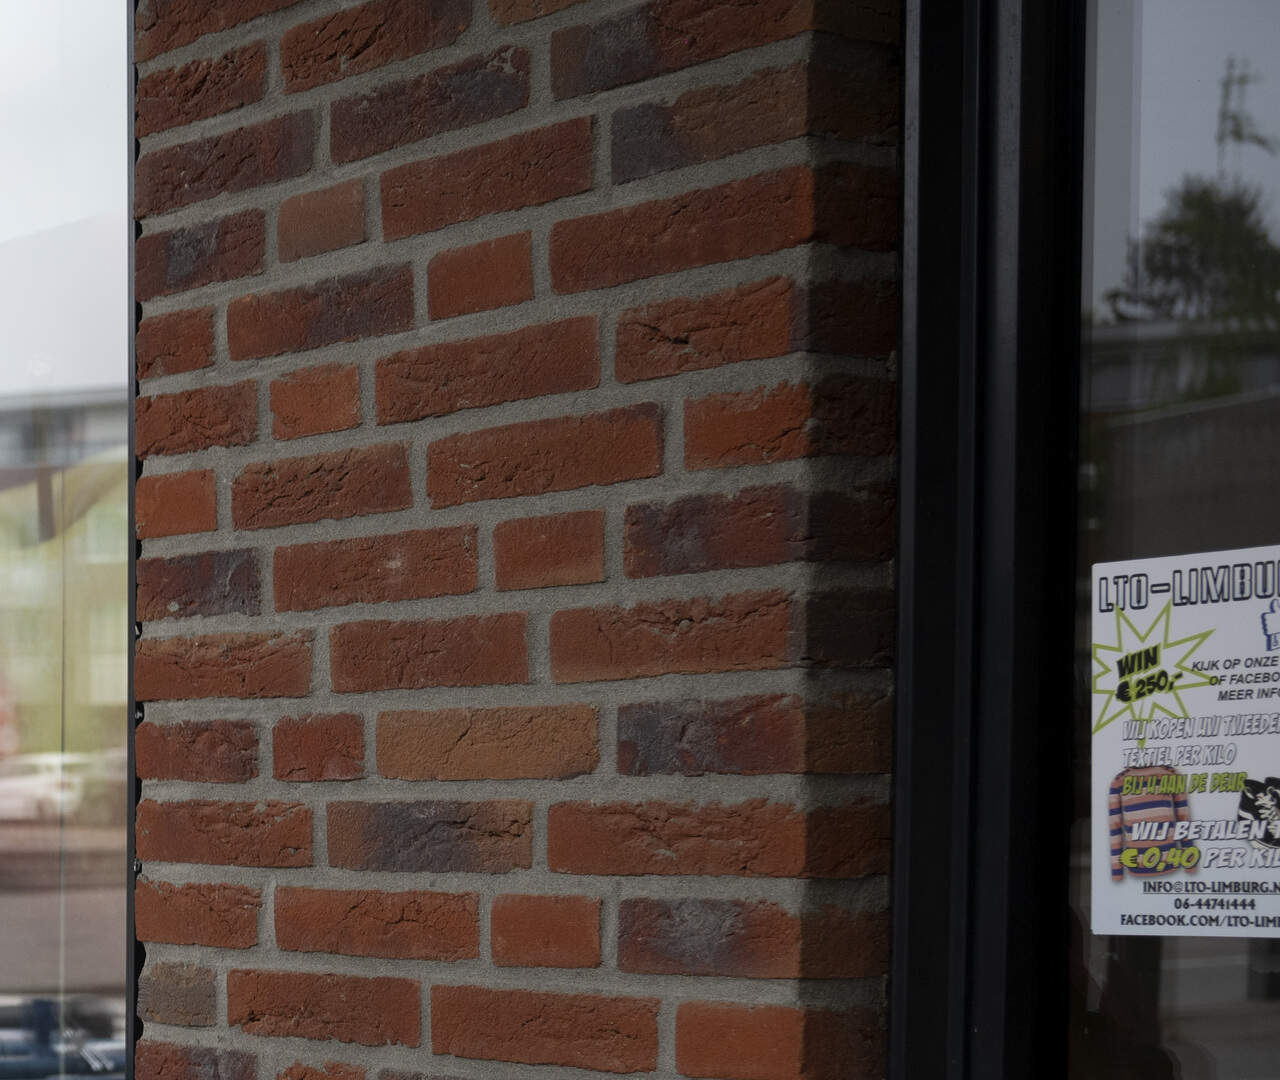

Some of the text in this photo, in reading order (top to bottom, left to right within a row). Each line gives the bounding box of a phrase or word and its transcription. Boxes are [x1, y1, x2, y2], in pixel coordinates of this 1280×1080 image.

[1099, 559, 1280, 613] LTO-LIMBU
[1116, 643, 1160, 679] WIN
[1192, 656, 1280, 672] KIJK OP ONZE
[1115, 670, 1184, 702] € 250,-
[1209, 675, 1227, 686] OF
[1218, 687, 1280, 701] MEER INF
[1122, 719, 1148, 741] WIJ
[1149, 717, 1195, 739] KOPEN
[1196, 715, 1222, 738] UW
[1122, 742, 1237, 769] TEXTIEL PER KILO
[1122, 772, 1248, 796] BIJ U AAN DE DEUR
[1131, 821, 1170, 841] WIJ
[1173, 819, 1268, 841] BETALEN
[1119, 847, 1139, 868] €
[1142, 846, 1201, 872] 0,40
[1203, 847, 1246, 869] PER
[1174, 898, 1256, 911] 06-44741444
[1120, 914, 1280, 928] FACEBOOK.COM/LTO-LIM
